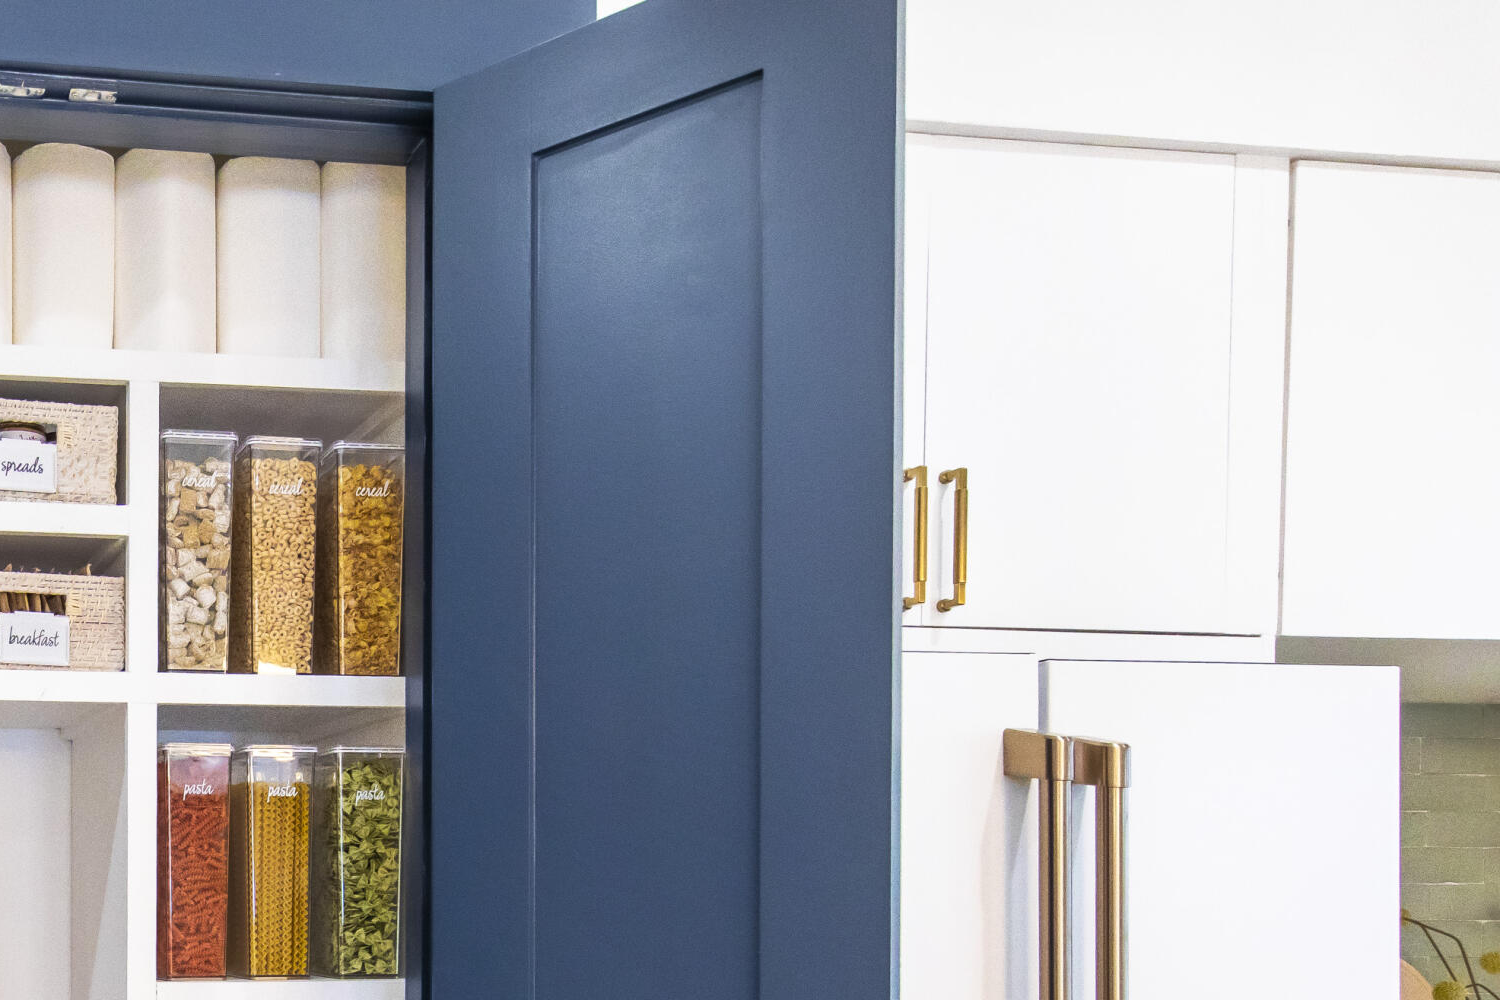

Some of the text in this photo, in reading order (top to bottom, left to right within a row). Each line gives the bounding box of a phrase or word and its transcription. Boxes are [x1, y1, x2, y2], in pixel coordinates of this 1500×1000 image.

[1, 456, 44, 477] spreads
[181, 470, 218, 488] cereal
[269, 478, 304, 496] cereal
[355, 480, 389, 497] cereal
[8, 626, 59, 648] breakfast
[183, 779, 215, 801] pasta
[267, 780, 298, 803] pasta
[355, 783, 386, 807] pasta
